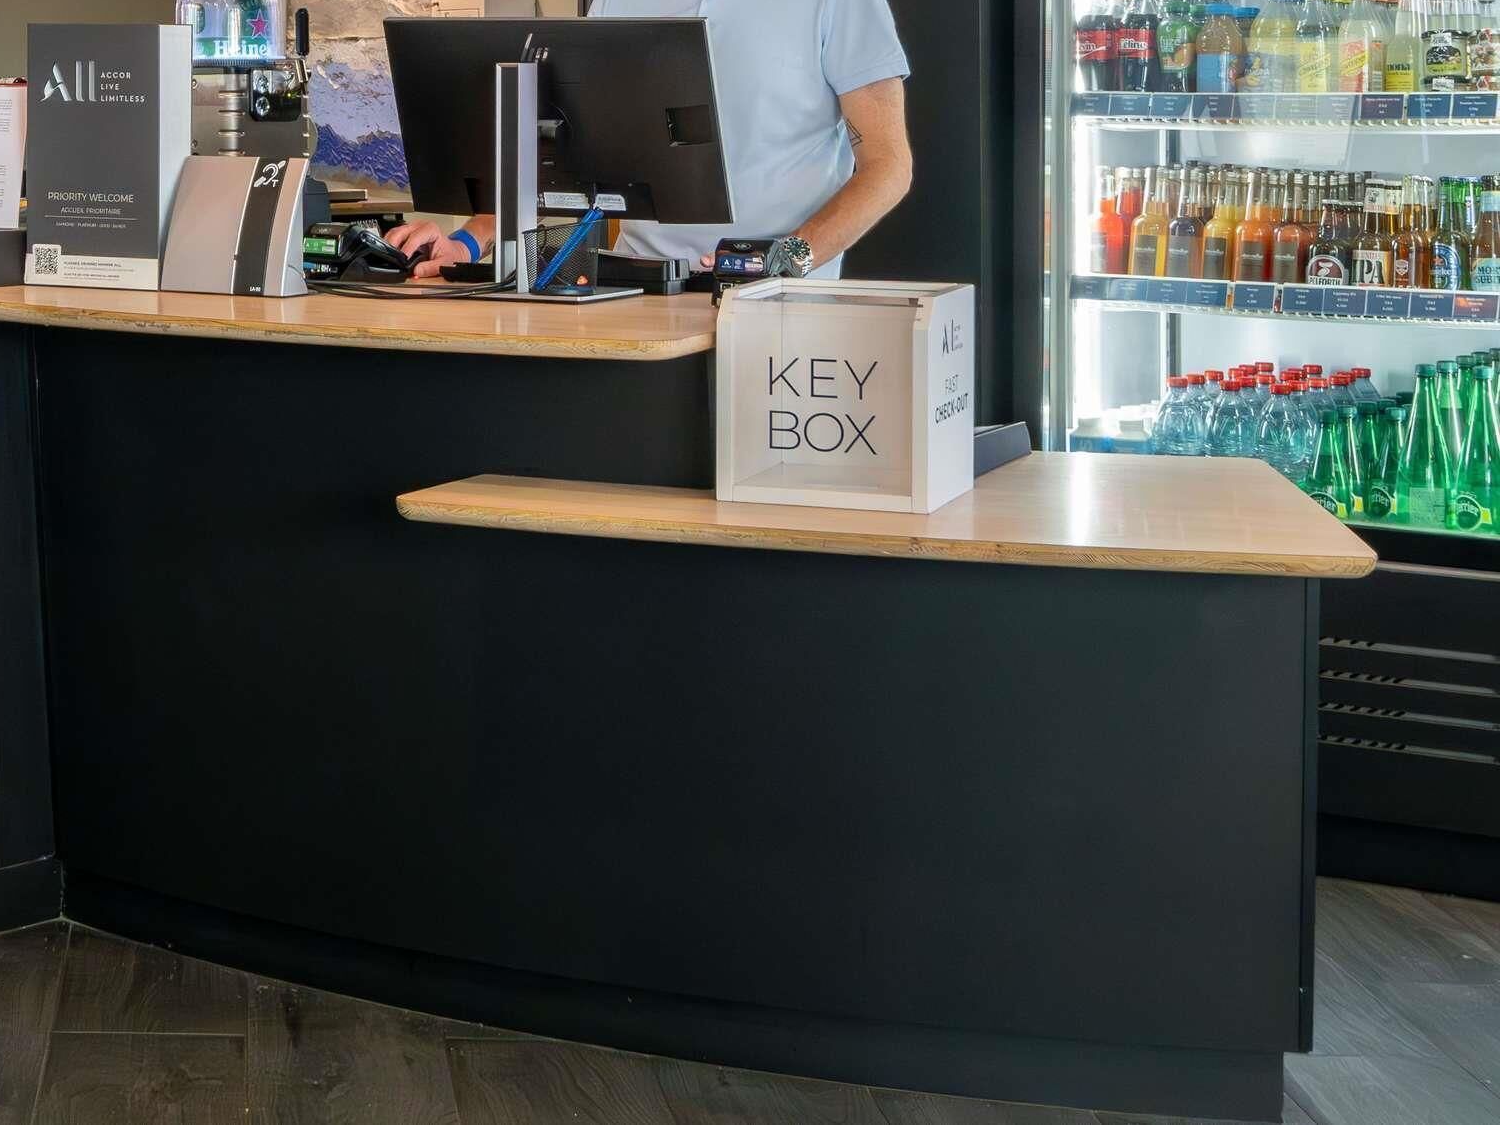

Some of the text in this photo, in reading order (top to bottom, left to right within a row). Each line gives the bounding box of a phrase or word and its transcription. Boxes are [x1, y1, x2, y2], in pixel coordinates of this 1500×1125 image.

[100, 71, 131, 79] ACCOR
[100, 95, 145, 103] LIMITLESS
[47, 191, 134, 203] PRIORITY WELCOME
[769, 356, 878, 400] KEY
[935, 393, 968, 424] CHECK-OUT
[769, 410, 877, 455] BOX
